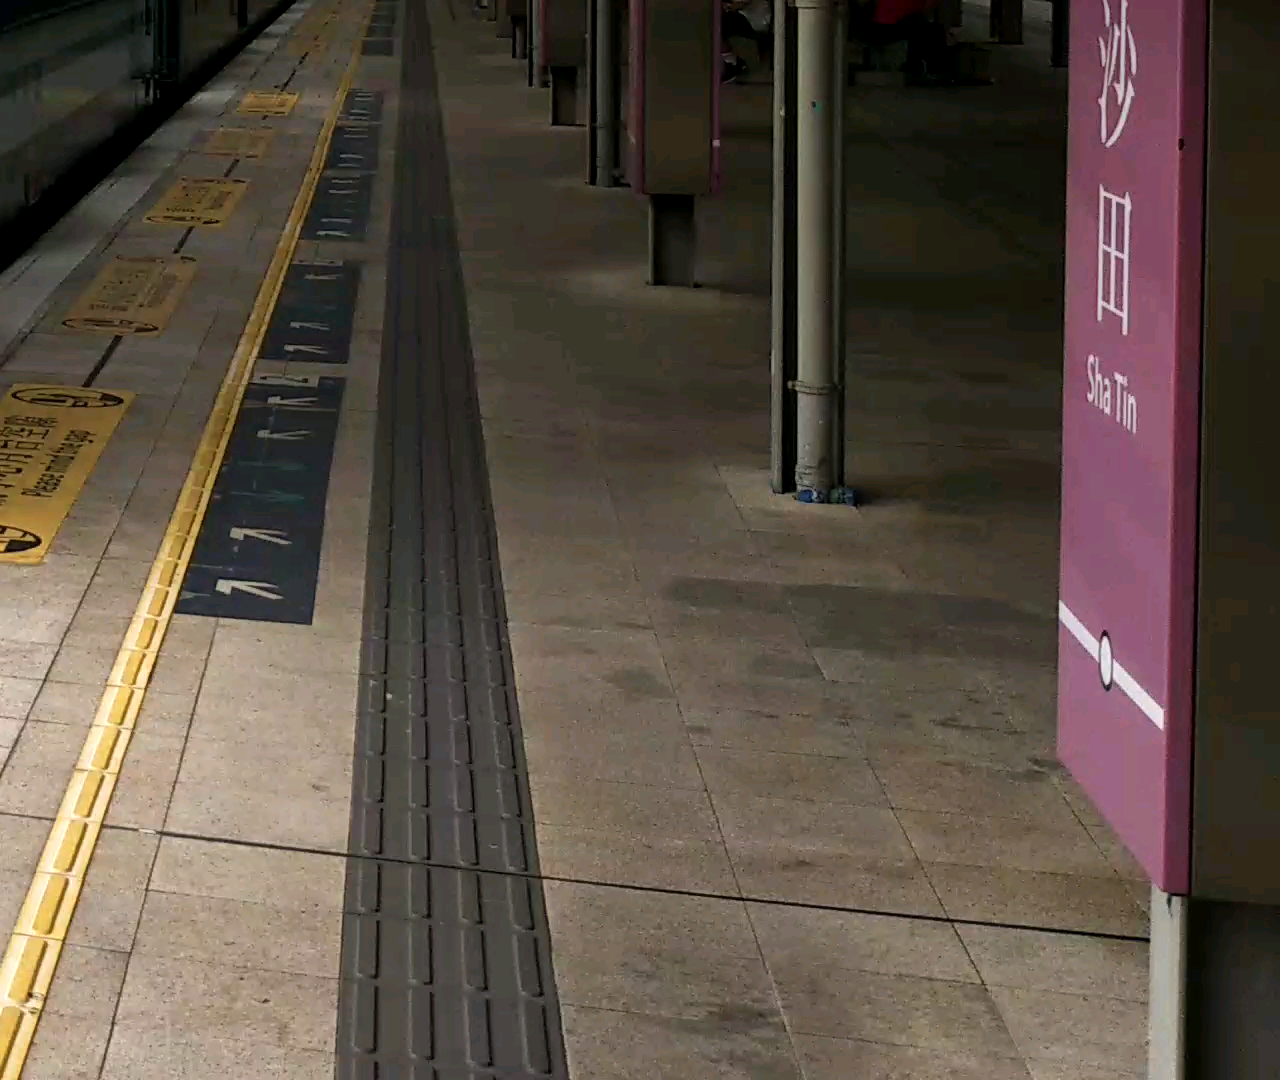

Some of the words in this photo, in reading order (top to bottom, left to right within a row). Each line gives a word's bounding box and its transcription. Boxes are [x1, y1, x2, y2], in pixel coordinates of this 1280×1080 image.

[1087, 354, 1111, 416] Sha
[1114, 372, 1137, 434] Tin
[20, 473, 65, 498] Please
